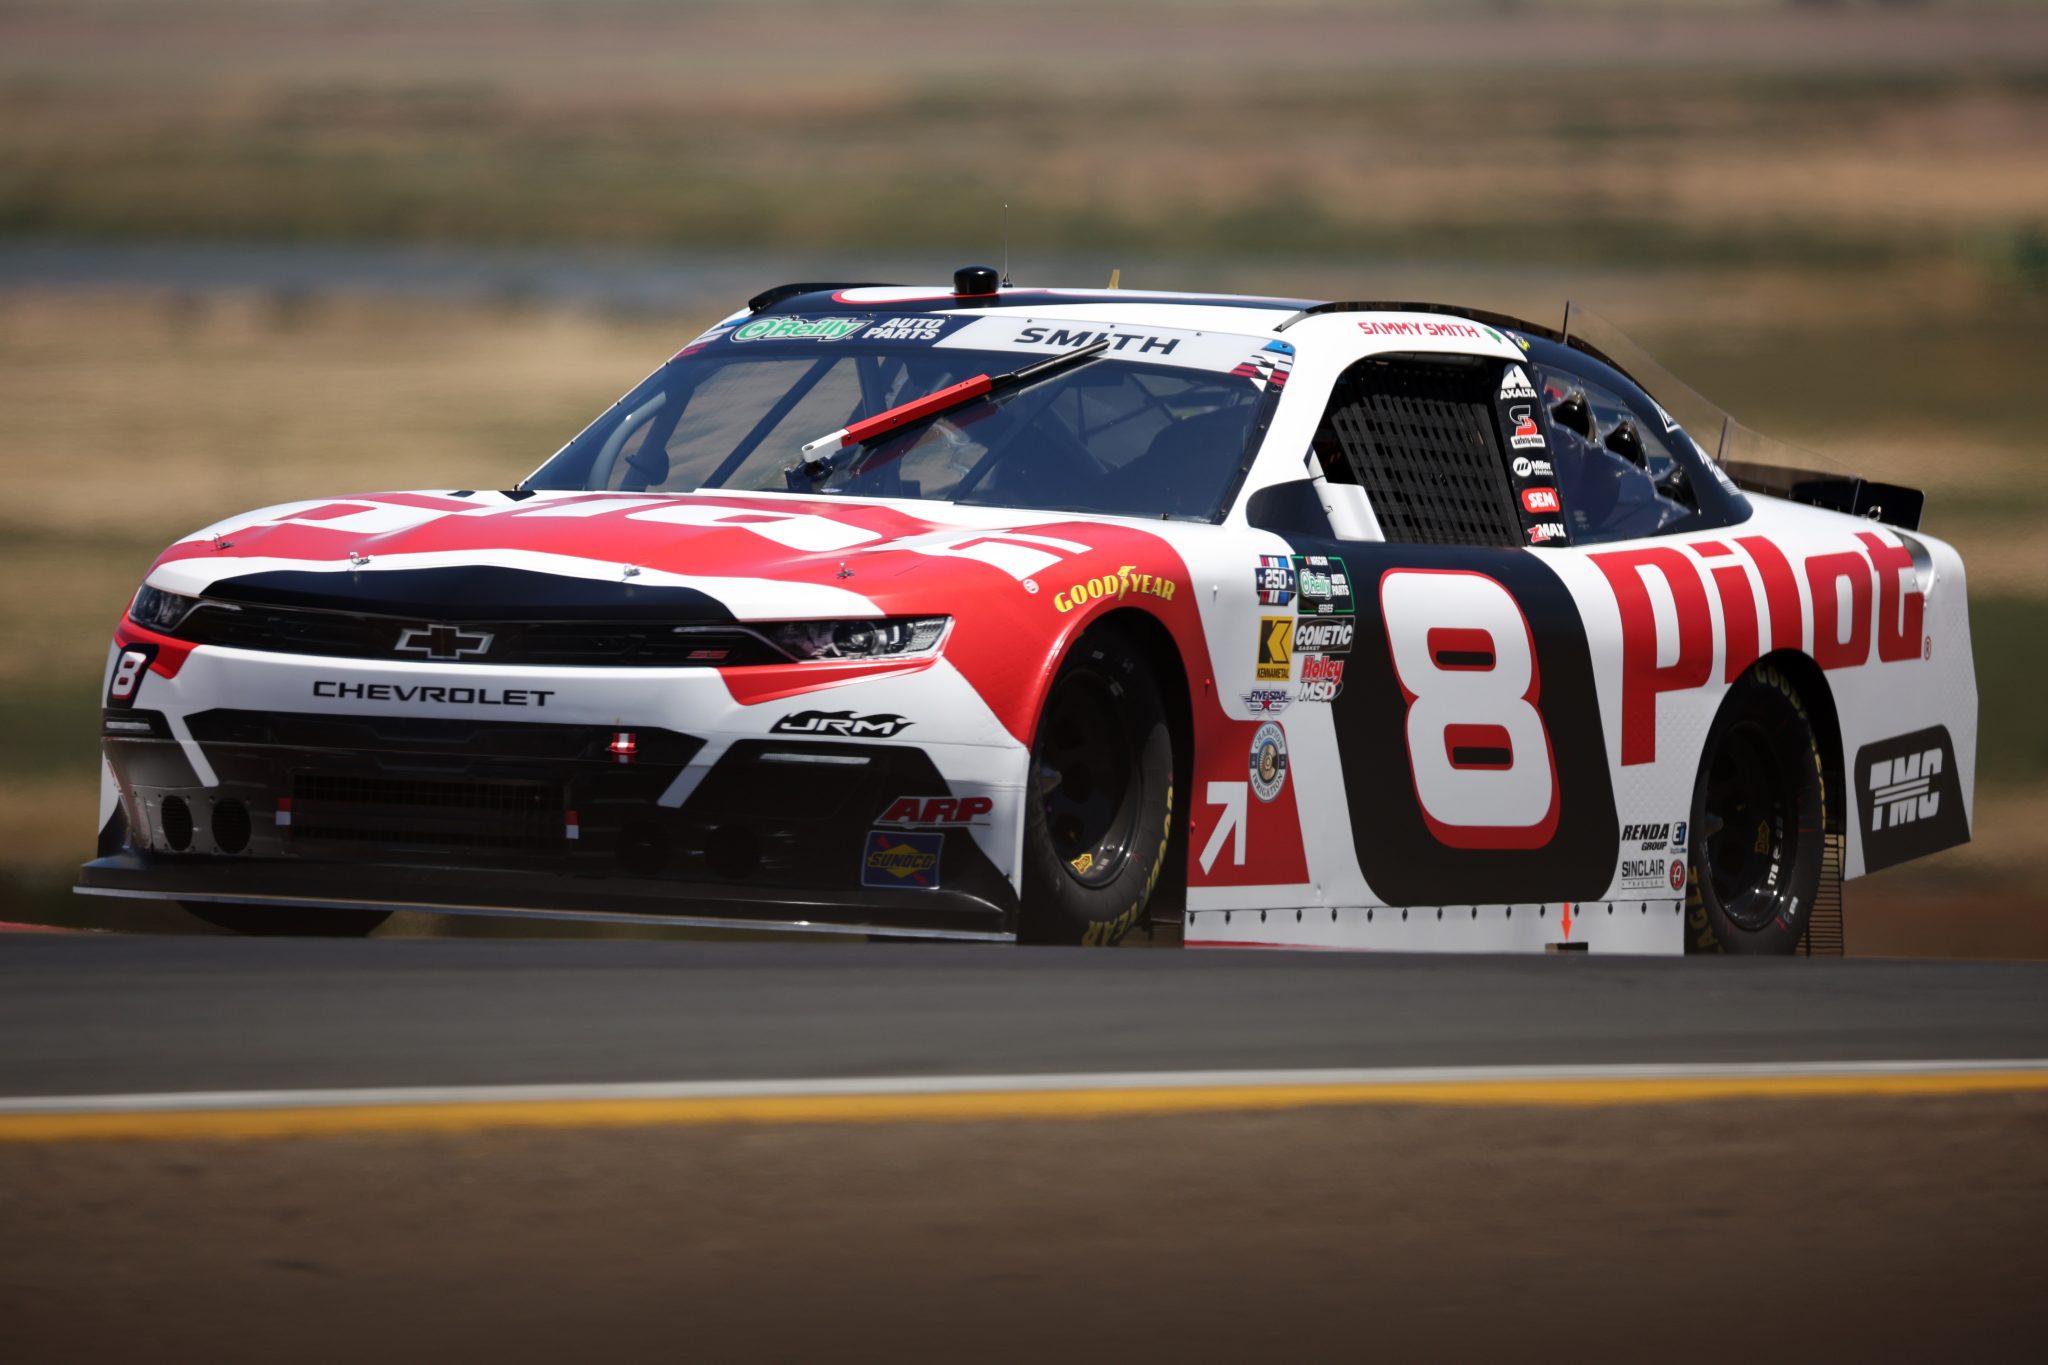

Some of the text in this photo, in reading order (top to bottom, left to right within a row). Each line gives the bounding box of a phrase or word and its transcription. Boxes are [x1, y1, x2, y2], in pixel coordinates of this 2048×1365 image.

[879, 317, 946, 329] AUTO
[1358, 322, 1480, 338] SAMMY SMITH
[862, 328, 941, 340] PARTS
[1013, 326, 1182, 355] SMITH
[1500, 388, 1537, 400] AXALTA
[1528, 491, 1556, 508] SEM
[1264, 569, 1287, 589] 250
[1332, 584, 1350, 596] PARTS
[1296, 624, 1353, 646] COMETIC
[110, 651, 147, 699] 8
[1256, 668, 1290, 679] KENNAMETAL
[313, 680, 556, 707] CHEVROLET
[1300, 682, 1337, 701] MSD
[1379, 567, 1560, 850] 8
[780, 718, 895, 736] JRM
[877, 797, 993, 823] ARP
[1621, 824, 1670, 841] RENDA
[1641, 841, 1668, 851] GROUP
[868, 852, 936, 869] SUNOCO
[1621, 859, 1665, 878] SINCLAIR
